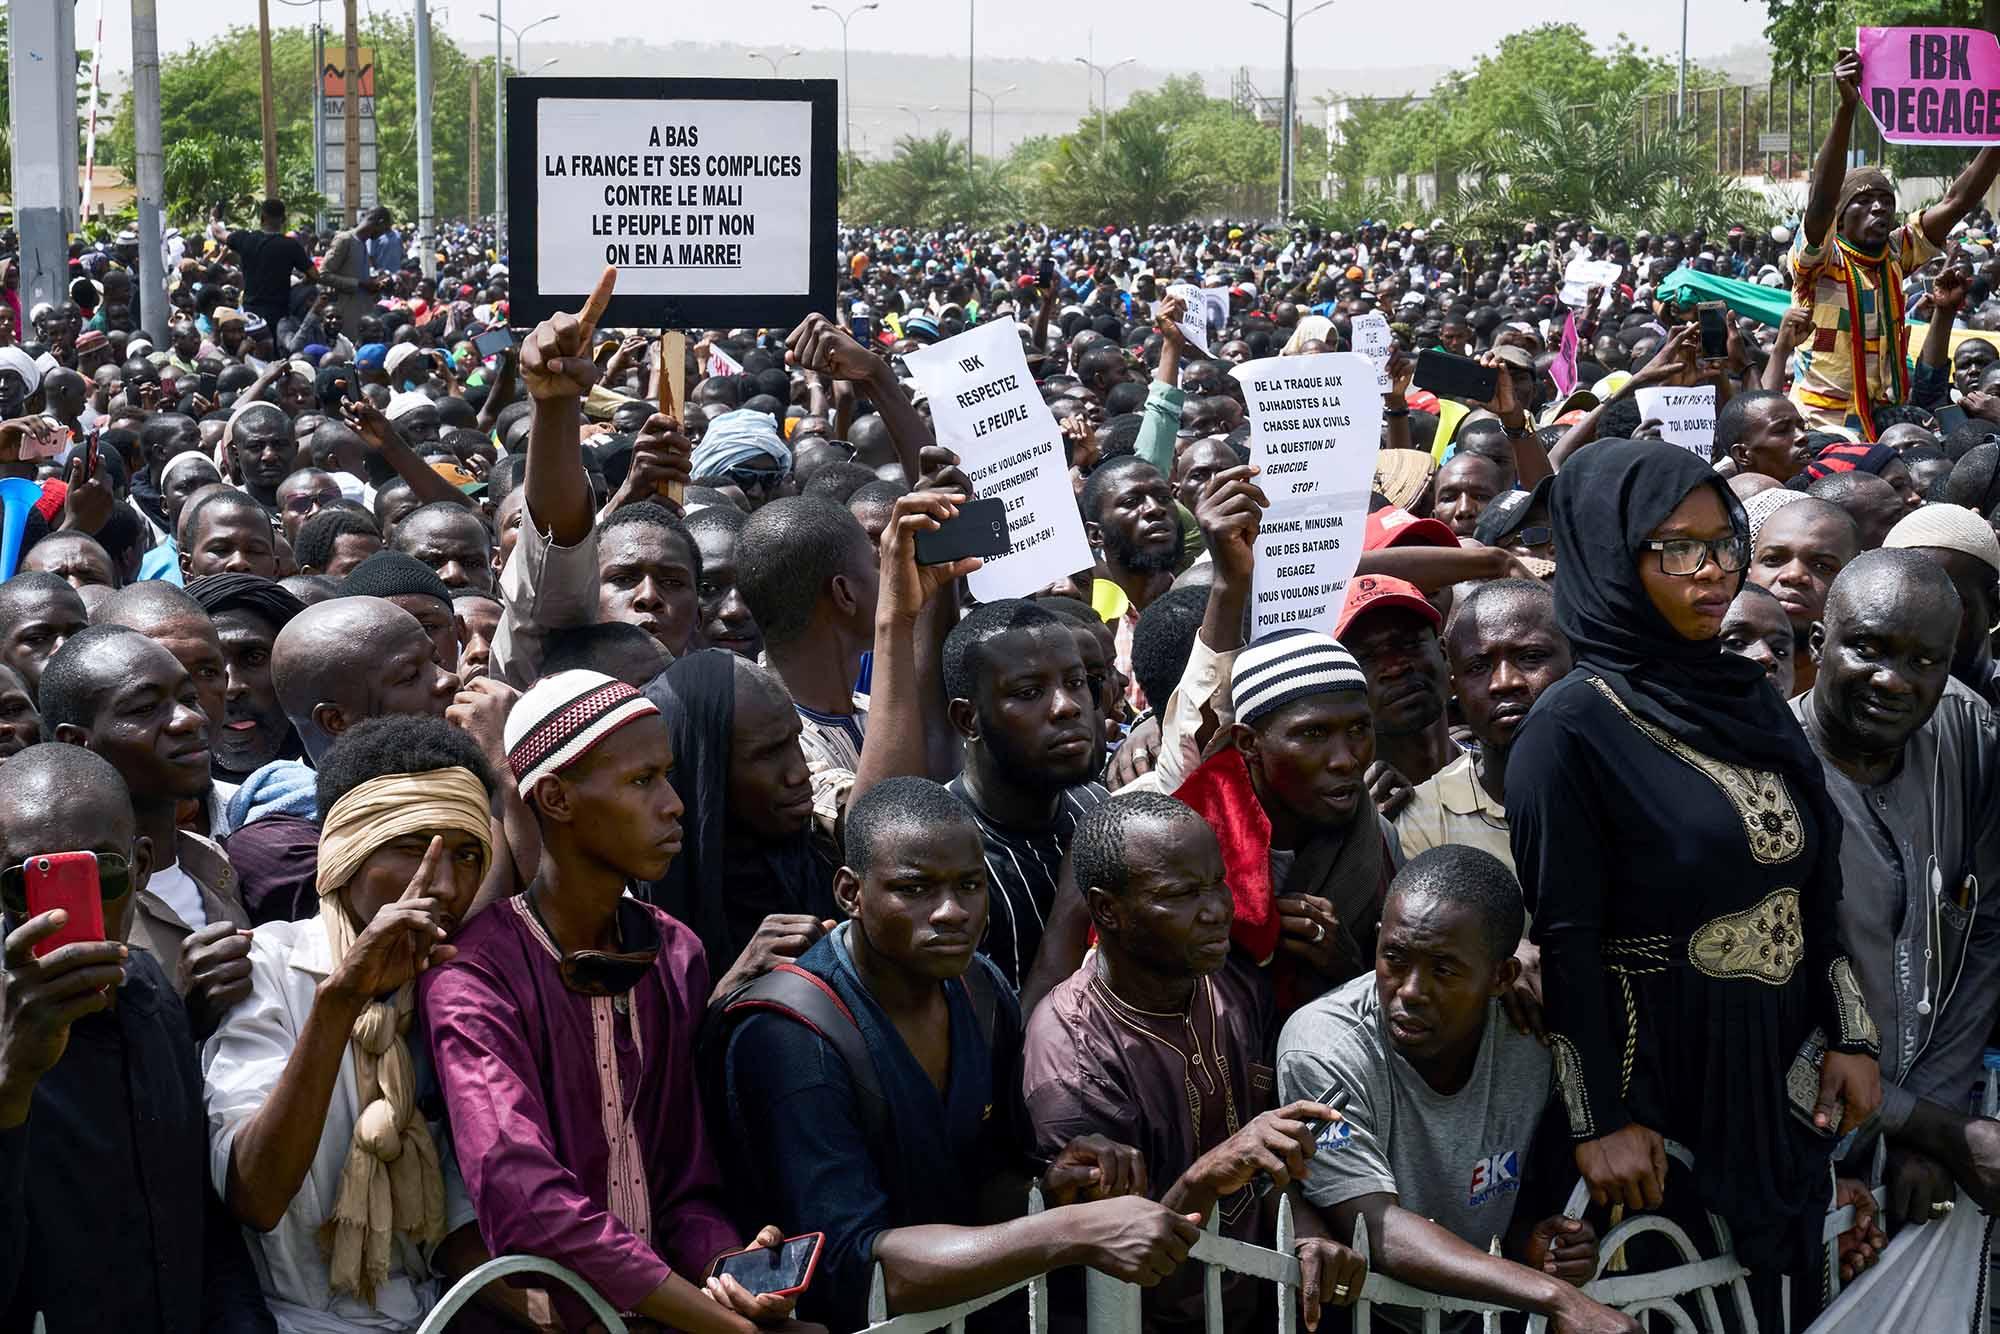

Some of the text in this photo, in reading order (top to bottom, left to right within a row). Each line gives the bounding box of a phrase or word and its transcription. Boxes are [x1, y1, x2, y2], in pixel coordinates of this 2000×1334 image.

[1910, 34, 1972, 80] IBK
[1871, 87, 2000, 134] DEGAGE
[648, 126, 698, 147] A BAS
[545, 155, 801, 177] LA FRANCE ET SES COMPLICES
[604, 185, 742, 206] CONTRE LE MALI
[592, 214, 754, 235] LE PEUPLE DIT NON
[606, 244, 742, 266] ON EN A MARRE!
[1366, 332, 1378, 344] TUE
[958, 355, 984, 373] IBK
[956, 375, 1019, 408] RESPECTEZ
[1254, 376, 1342, 392] DE LA TRAQUE AUX
[1259, 396, 1340, 412] DJIHADISTES A LA
[972, 404, 1028, 438] LE PEUPLE
[1263, 416, 1350, 432] CHASSE AUX CIVILS
[1266, 438, 1336, 455] LA QUESTION DU
[988, 463, 998, 476] NE
[998, 449, 1032, 471] VOULONS
[1032, 442, 1052, 457] PLUS
[1266, 461, 1308, 475] GENOCIDE
[982, 466, 1039, 499] GOUVERNEMENT
[1291, 482, 1314, 494] STOP
[1015, 496, 1024, 508] ET
[1258, 516, 1344, 535] ARKHANE, MINUSMA
[1026, 528, 1051, 548] VA-T-EN
[1266, 538, 1340, 558] QUE DES BATARDS
[1276, 564, 1316, 578] DEGAGEZ
[1258, 590, 1279, 604] NOUS
[1280, 585, 1320, 600] VOULONS
[1321, 584, 1332, 594] UN
[1258, 613, 1279, 626] POUR
[1282, 610, 1296, 622] LES
